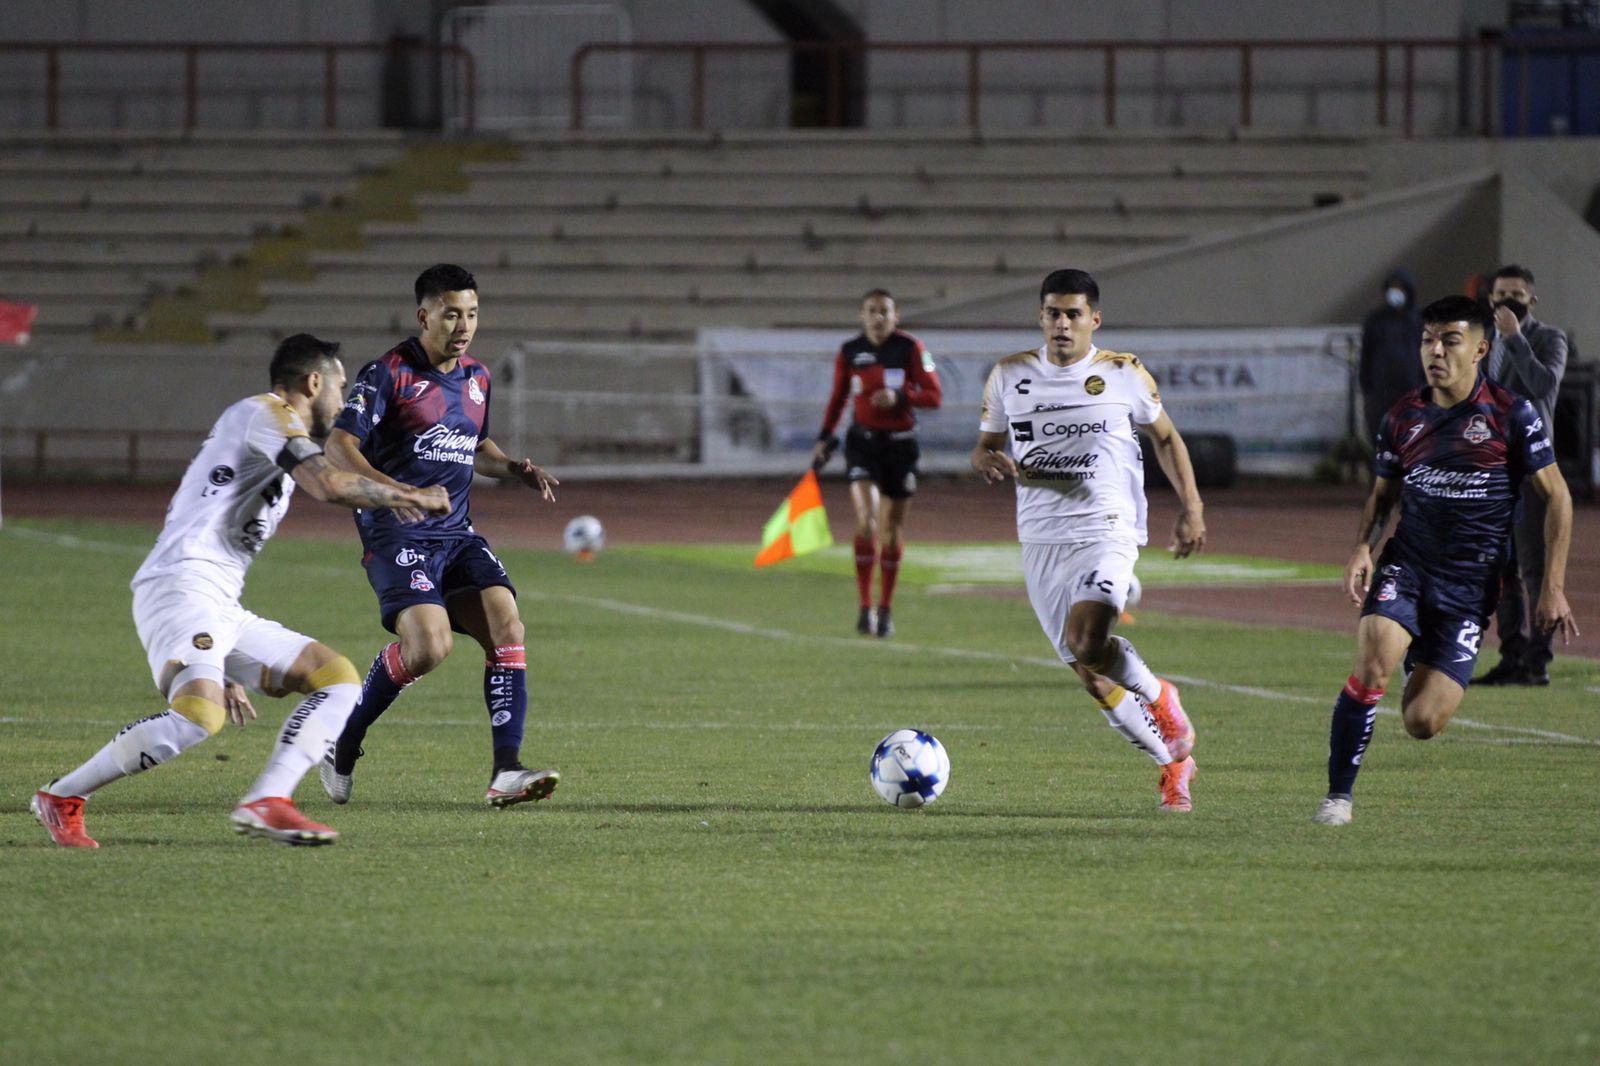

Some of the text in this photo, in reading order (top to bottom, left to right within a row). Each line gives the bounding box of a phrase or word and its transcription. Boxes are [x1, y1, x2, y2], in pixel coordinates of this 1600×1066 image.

[1042, 419, 1108, 438] Coppel
[1020, 446, 1099, 470] Caliente
[1025, 469, 1096, 481] caliente.mx
[281, 691, 329, 745] PEGADURO
